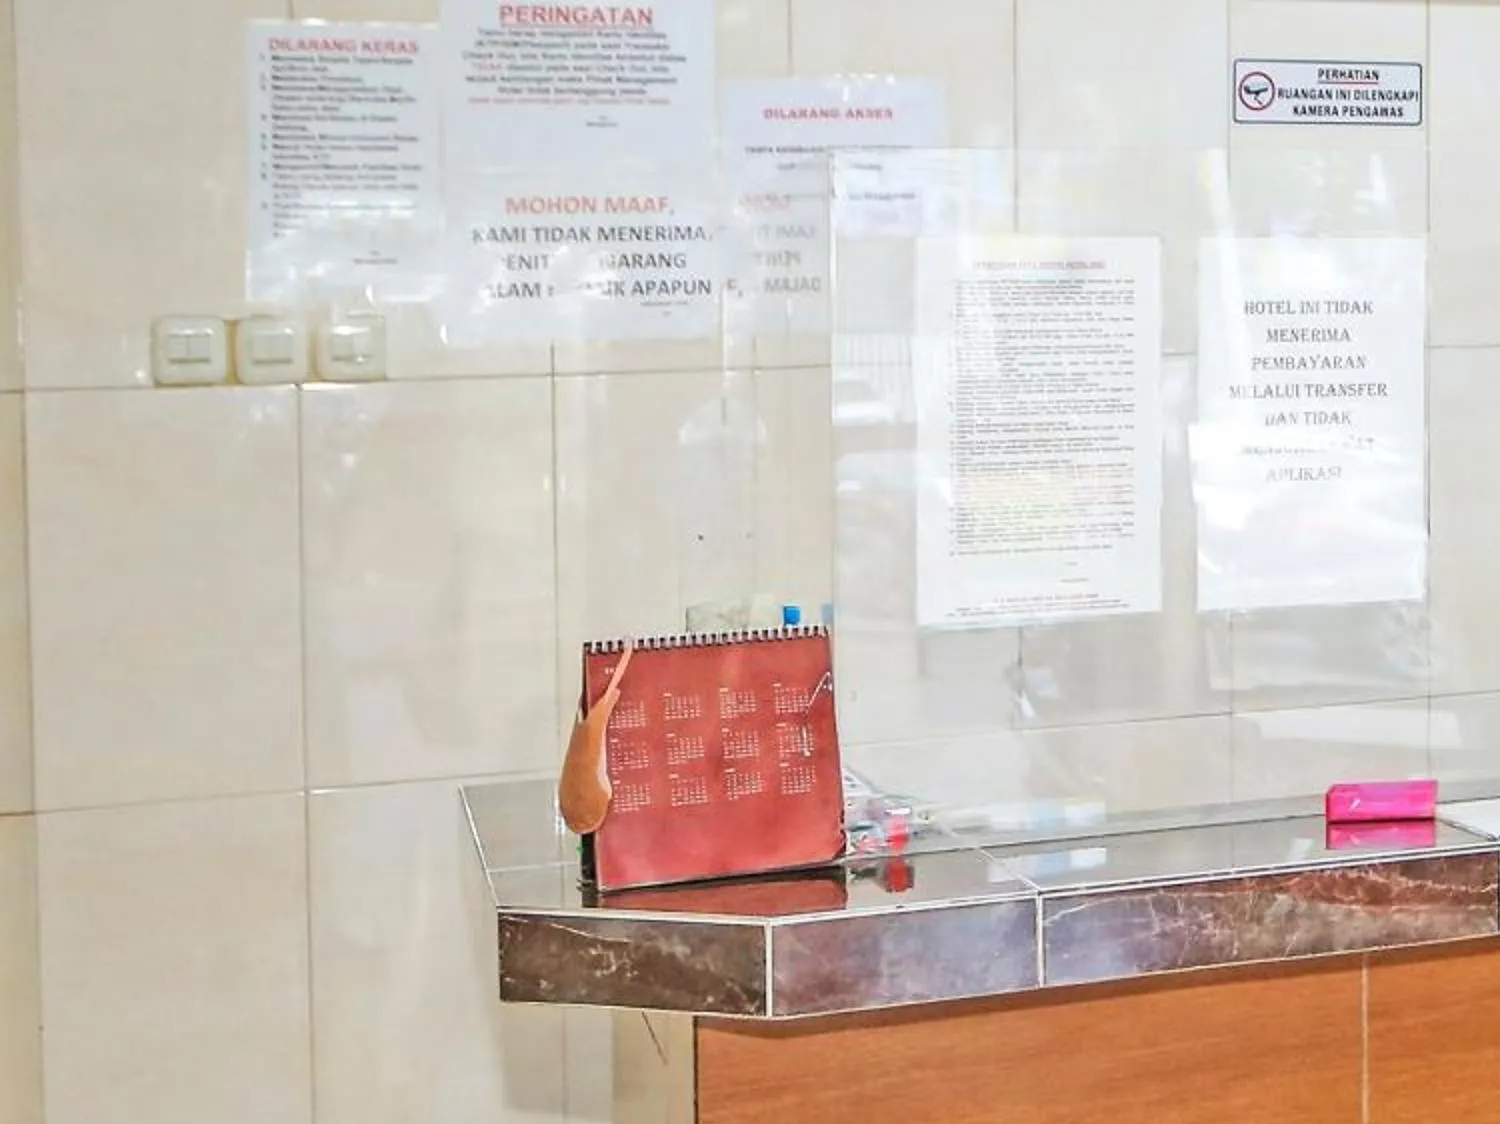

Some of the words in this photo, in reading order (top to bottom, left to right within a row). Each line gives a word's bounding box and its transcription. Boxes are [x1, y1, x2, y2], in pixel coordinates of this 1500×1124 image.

[499, 5, 654, 25] PERINGATAN
[268, 38, 357, 51] DILARANG
[361, 40, 418, 53] KERAS
[1317, 68, 1380, 81] PERHATIAN
[1277, 88, 1333, 101] RUANGAN
[1335, 88, 1350, 101] INI
[1353, 89, 1419, 103] DILENGKAPI
[1293, 106, 1339, 117] KAMERA
[1342, 107, 1404, 118] PENGAWAS
[506, 198, 597, 215] MOHON
[604, 197, 675, 217] MAAF,
[473, 226, 527, 242] KAMI
[530, 226, 591, 242] TIDAK
[630, 278, 712, 297] APAPUN
[1244, 300, 1297, 316] HOTEL
[1301, 300, 1321, 315] INI
[1324, 299, 1375, 315] TIDAK
[1266, 327, 1352, 343] MENERIMA
[1251, 355, 1369, 371] PEMBAYARAN
[1304, 382, 1389, 399] TRANSFER
[1304, 410, 1352, 426] TIDAK
